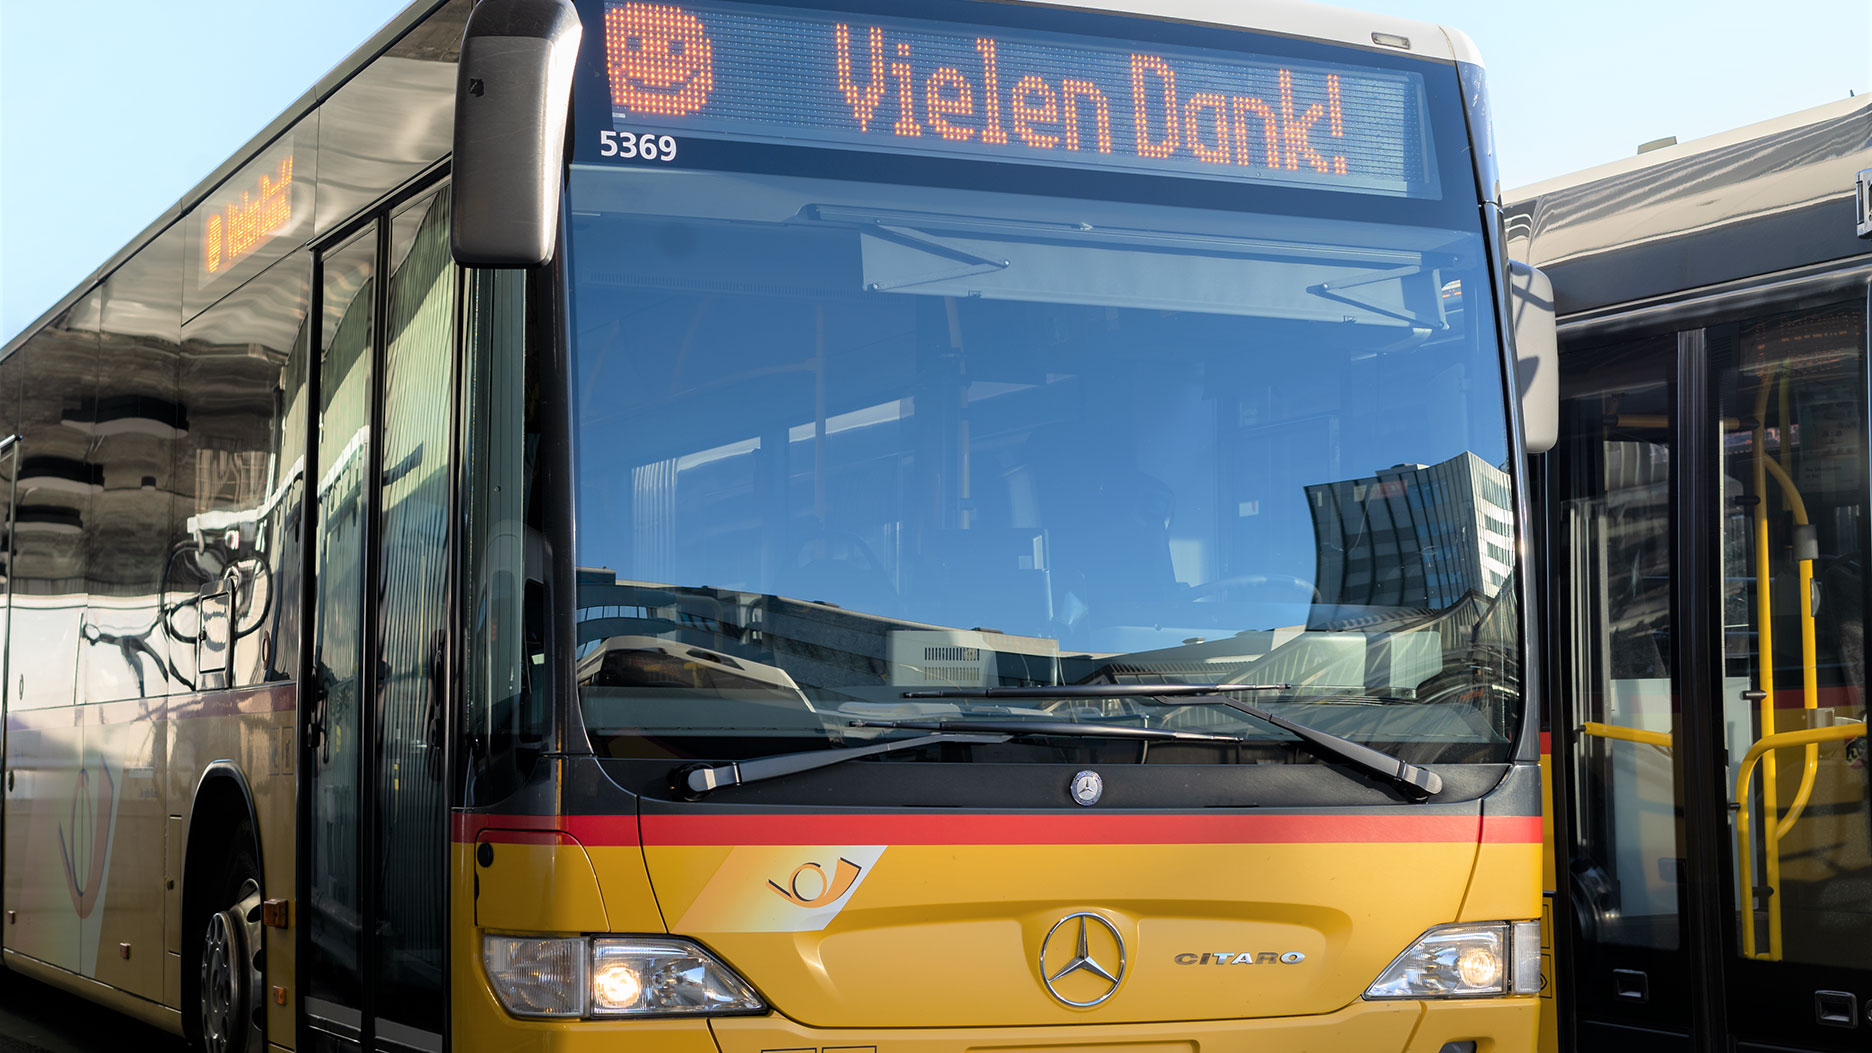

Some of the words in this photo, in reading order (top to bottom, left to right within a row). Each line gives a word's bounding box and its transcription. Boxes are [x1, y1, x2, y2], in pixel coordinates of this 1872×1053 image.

[836, 23, 1111, 154] Vielen
[1131, 53, 1346, 174] Dank!
[600, 130, 677, 162] 5369
[1174, 951, 1306, 965] CITARO
